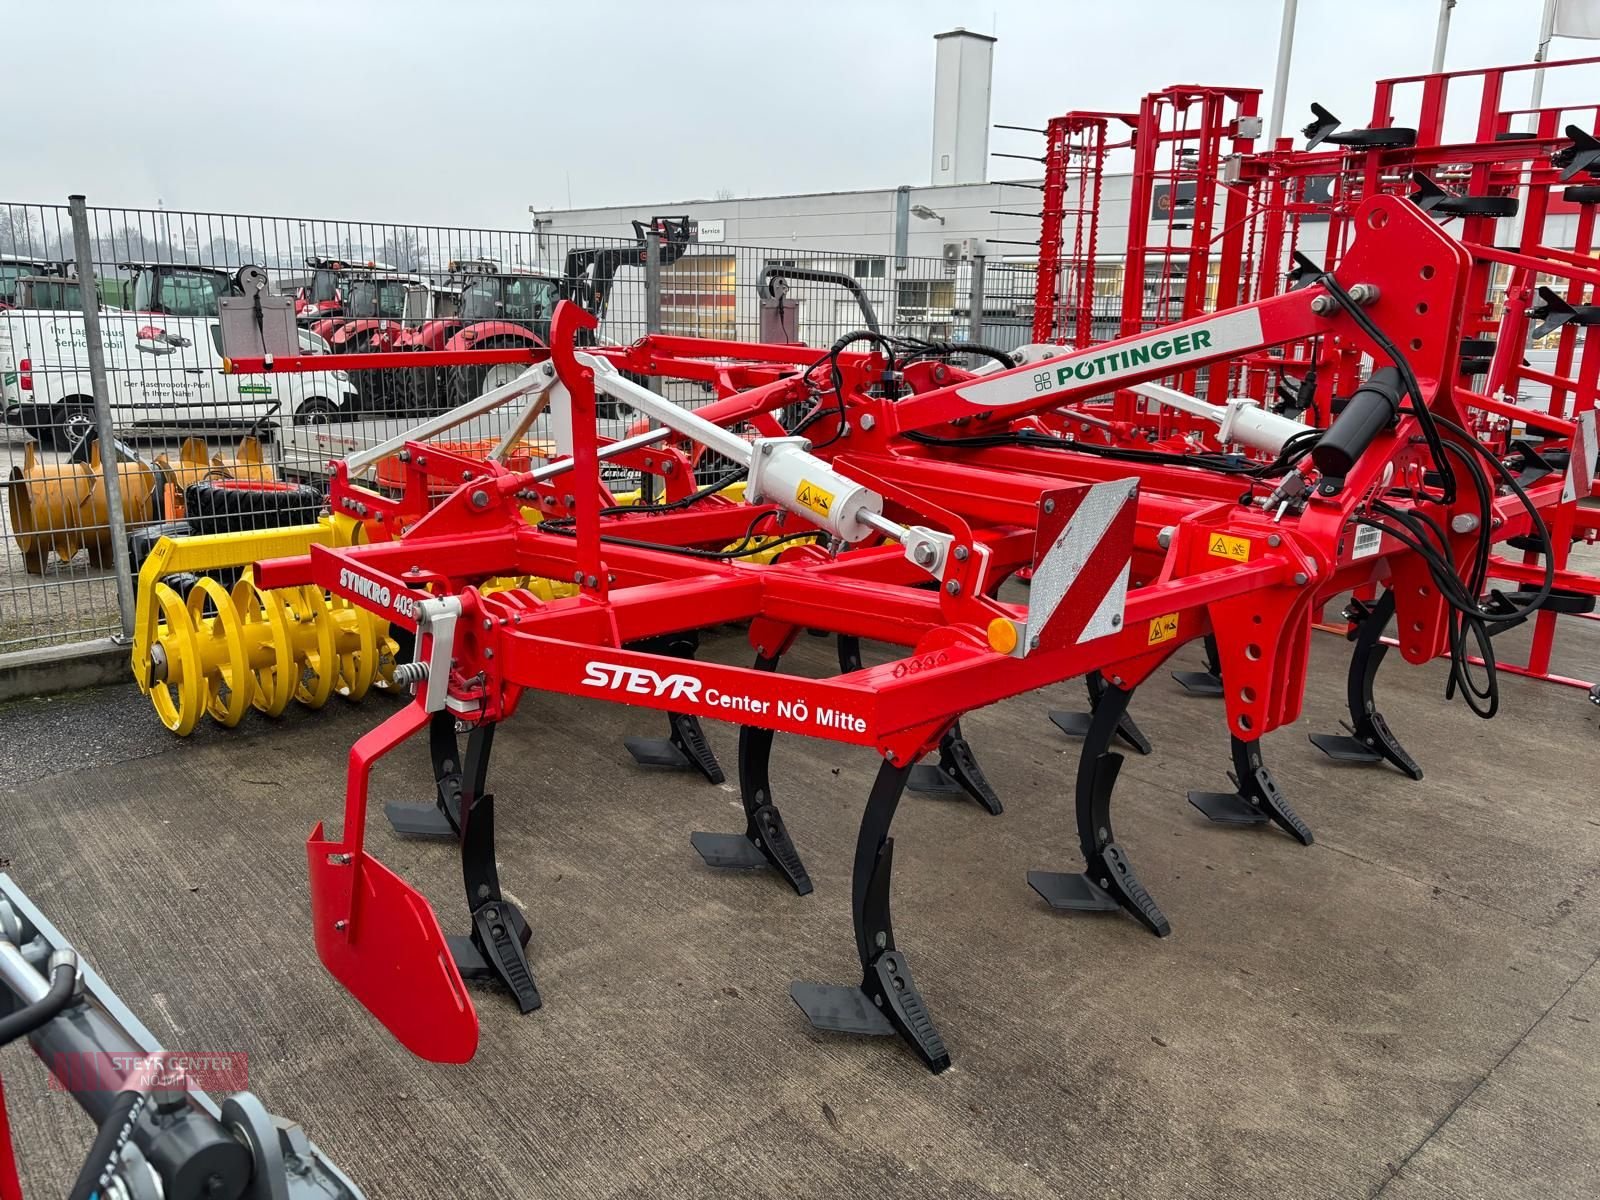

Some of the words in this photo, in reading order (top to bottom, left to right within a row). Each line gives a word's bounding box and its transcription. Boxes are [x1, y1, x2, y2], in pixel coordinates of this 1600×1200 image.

[55, 339, 123, 349] Servicobil
[1056, 329, 1213, 386] PÖTTINGER
[340, 567, 391, 608] SYNKRO
[581, 661, 702, 703] STEYR
[705, 689, 770, 716] Center
[777, 699, 808, 722] NÖ
[816, 707, 867, 733] Mitte
